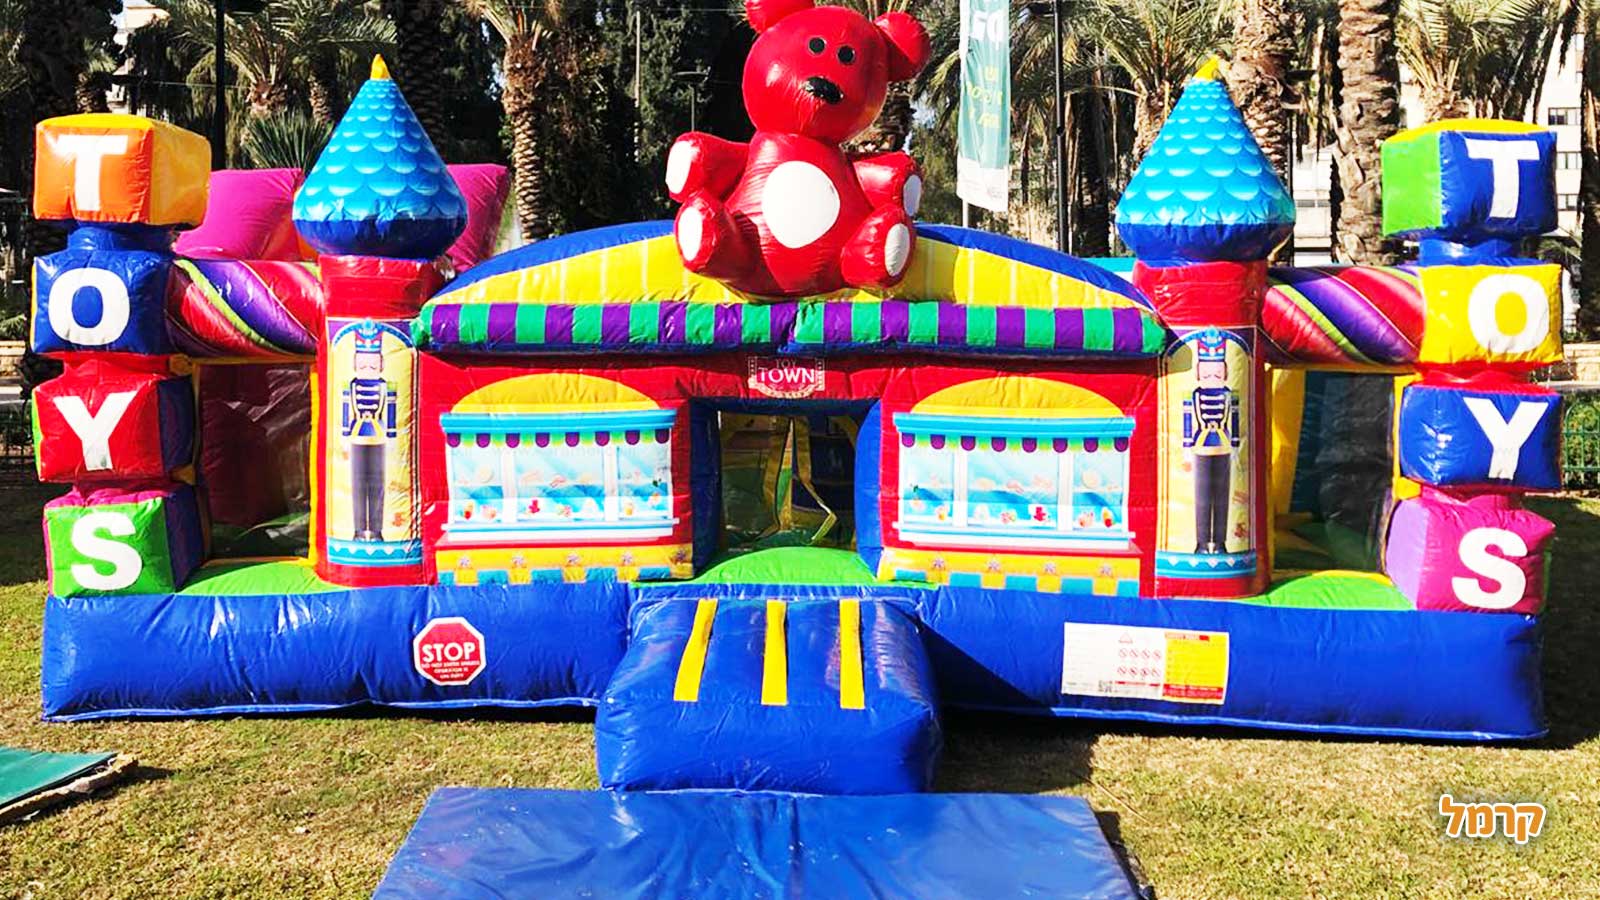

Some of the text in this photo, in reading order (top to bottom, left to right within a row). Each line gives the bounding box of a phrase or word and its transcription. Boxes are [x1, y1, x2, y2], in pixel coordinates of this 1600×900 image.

[48, 133, 143, 592] TOYS
[758, 367, 815, 383] TOWN
[1451, 138, 1550, 610] TOYS
[422, 642, 476, 663] STOP
